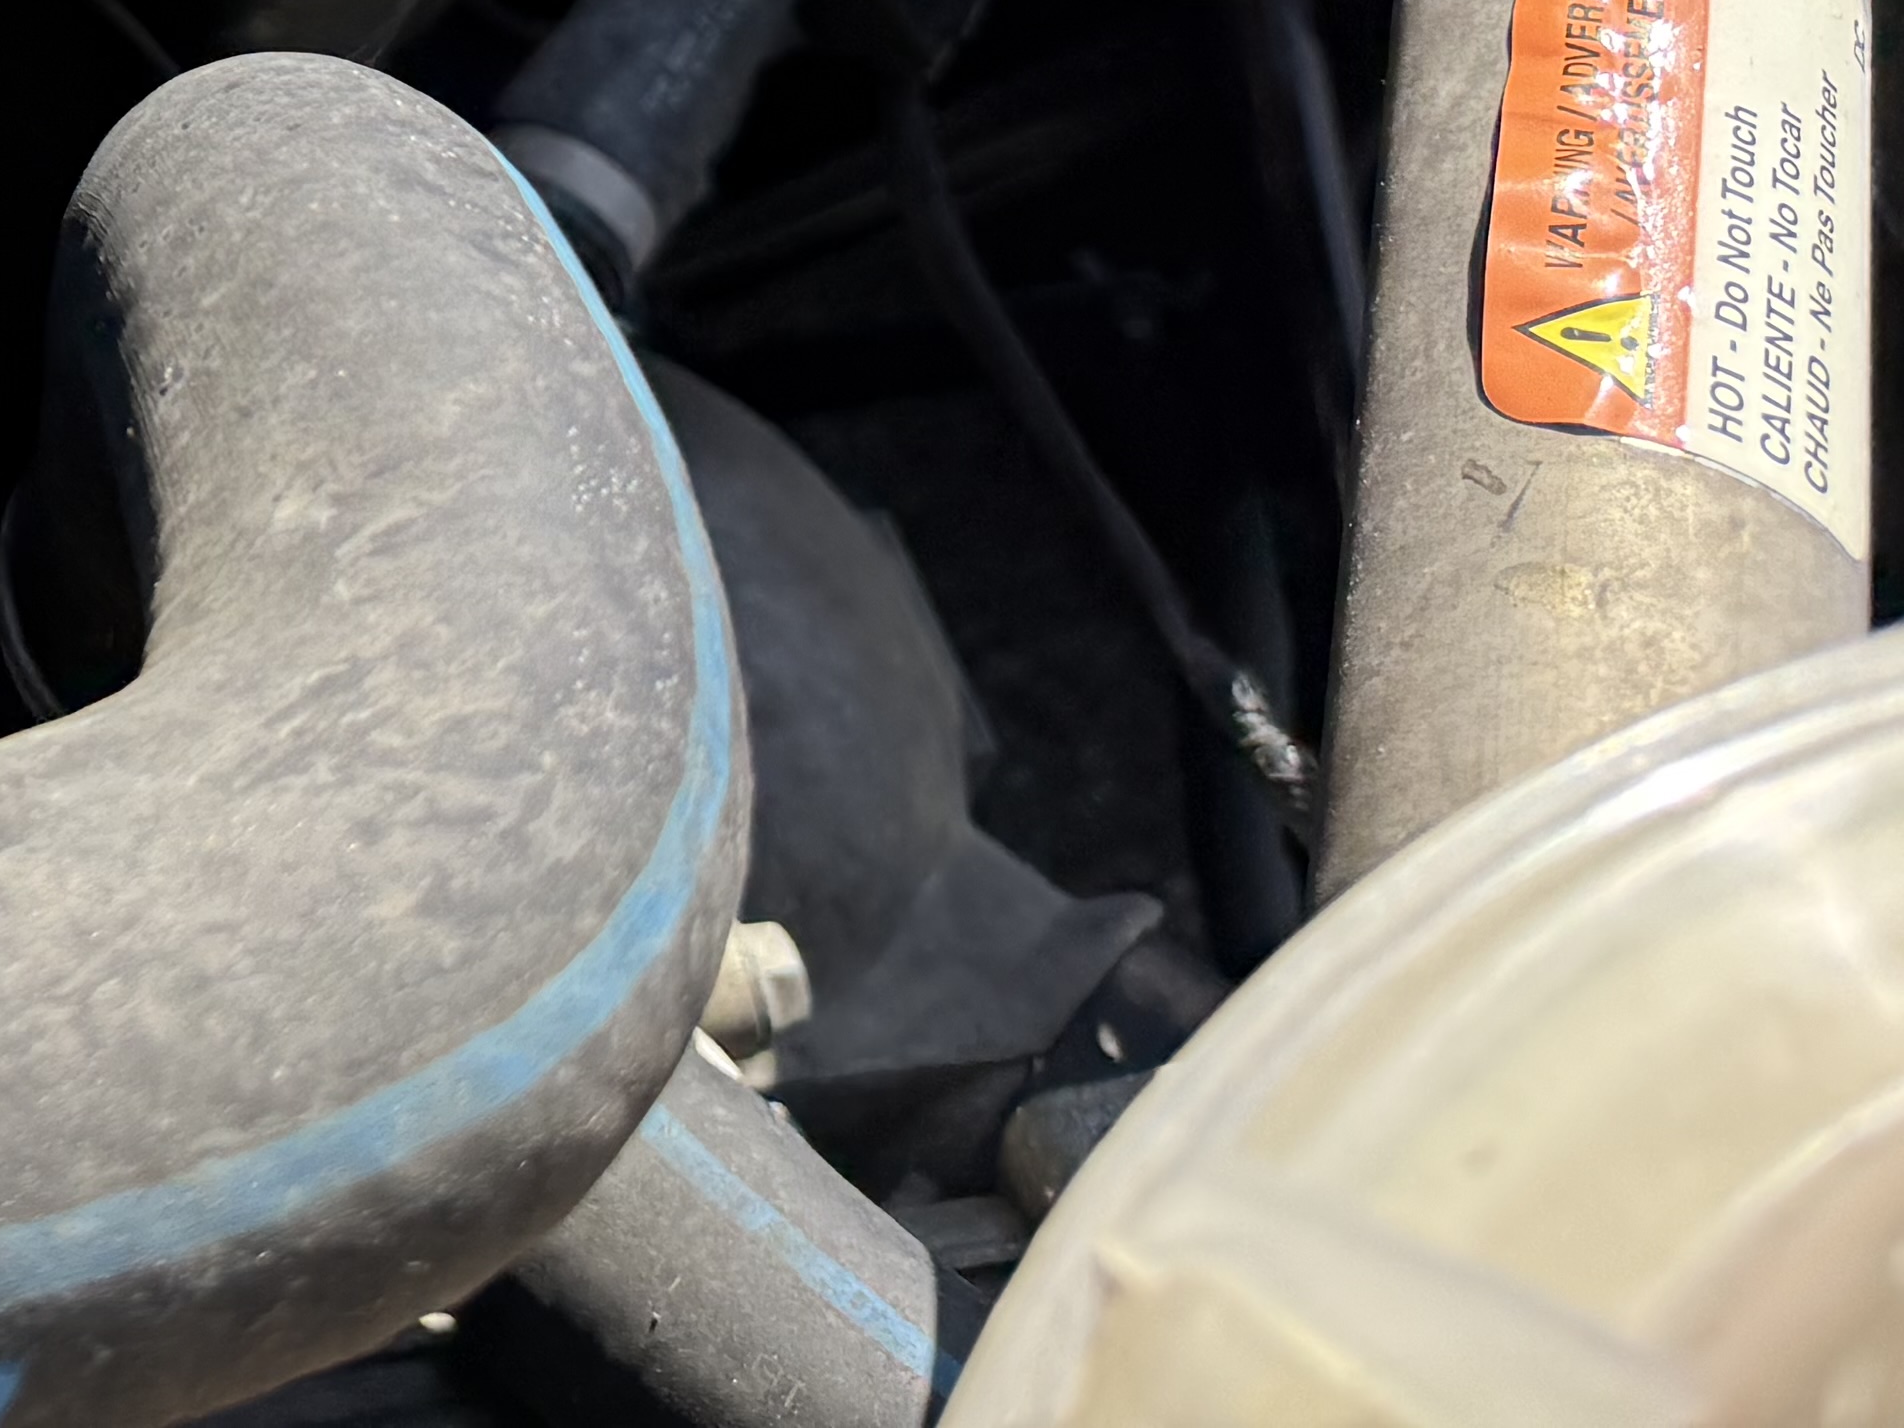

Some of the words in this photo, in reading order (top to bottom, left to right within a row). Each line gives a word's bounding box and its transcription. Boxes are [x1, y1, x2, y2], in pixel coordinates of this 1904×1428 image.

[1722, 105, 1758, 203] Touch
[1771, 101, 1802, 196] Tocar
[1814, 70, 1838, 205] Toucher
[1717, 209, 1752, 274] Not
[1769, 202, 1798, 254] No
[1811, 210, 1834, 277] Pas
[1715, 285, 1749, 332] Do
[1809, 285, 1833, 333] Ne
[1708, 355, 1745, 443] HOT
[1760, 276, 1796, 466] CALIENTE
[1804, 360, 1830, 495] CHAUD
